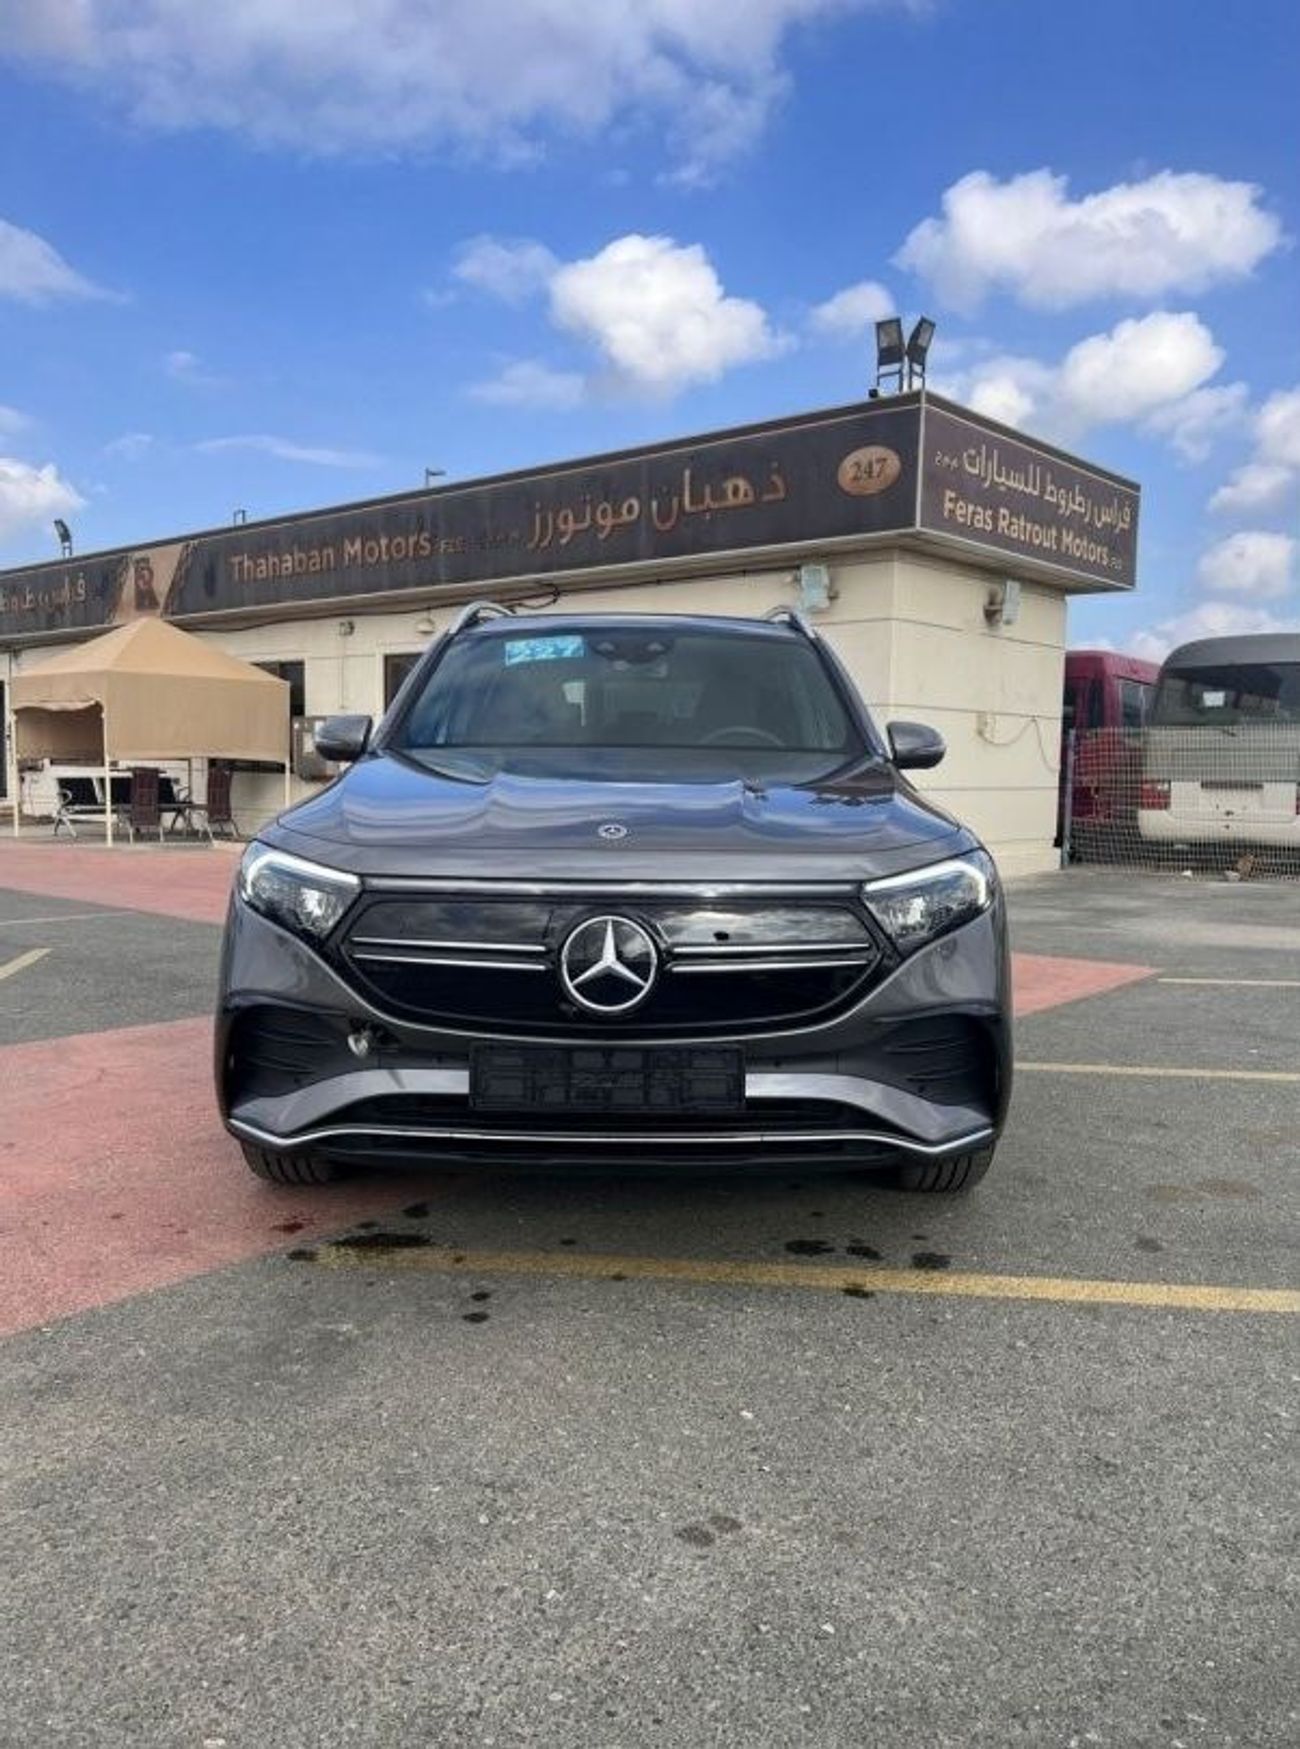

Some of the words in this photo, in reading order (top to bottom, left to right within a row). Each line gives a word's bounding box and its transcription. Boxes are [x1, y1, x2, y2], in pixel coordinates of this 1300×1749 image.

[651, 459, 788, 531] ذهبان
[849, 456, 890, 483] 247
[963, 444, 1040, 496] للسيارات
[526, 495, 641, 550] موتورز
[1044, 473, 1092, 523] رطروط
[1094, 497, 1134, 533] فراس
[343, 531, 432, 568] Motors
[943, 488, 993, 532] Feras
[997, 505, 1058, 552] Ratrout
[1061, 526, 1110, 567] Motors
